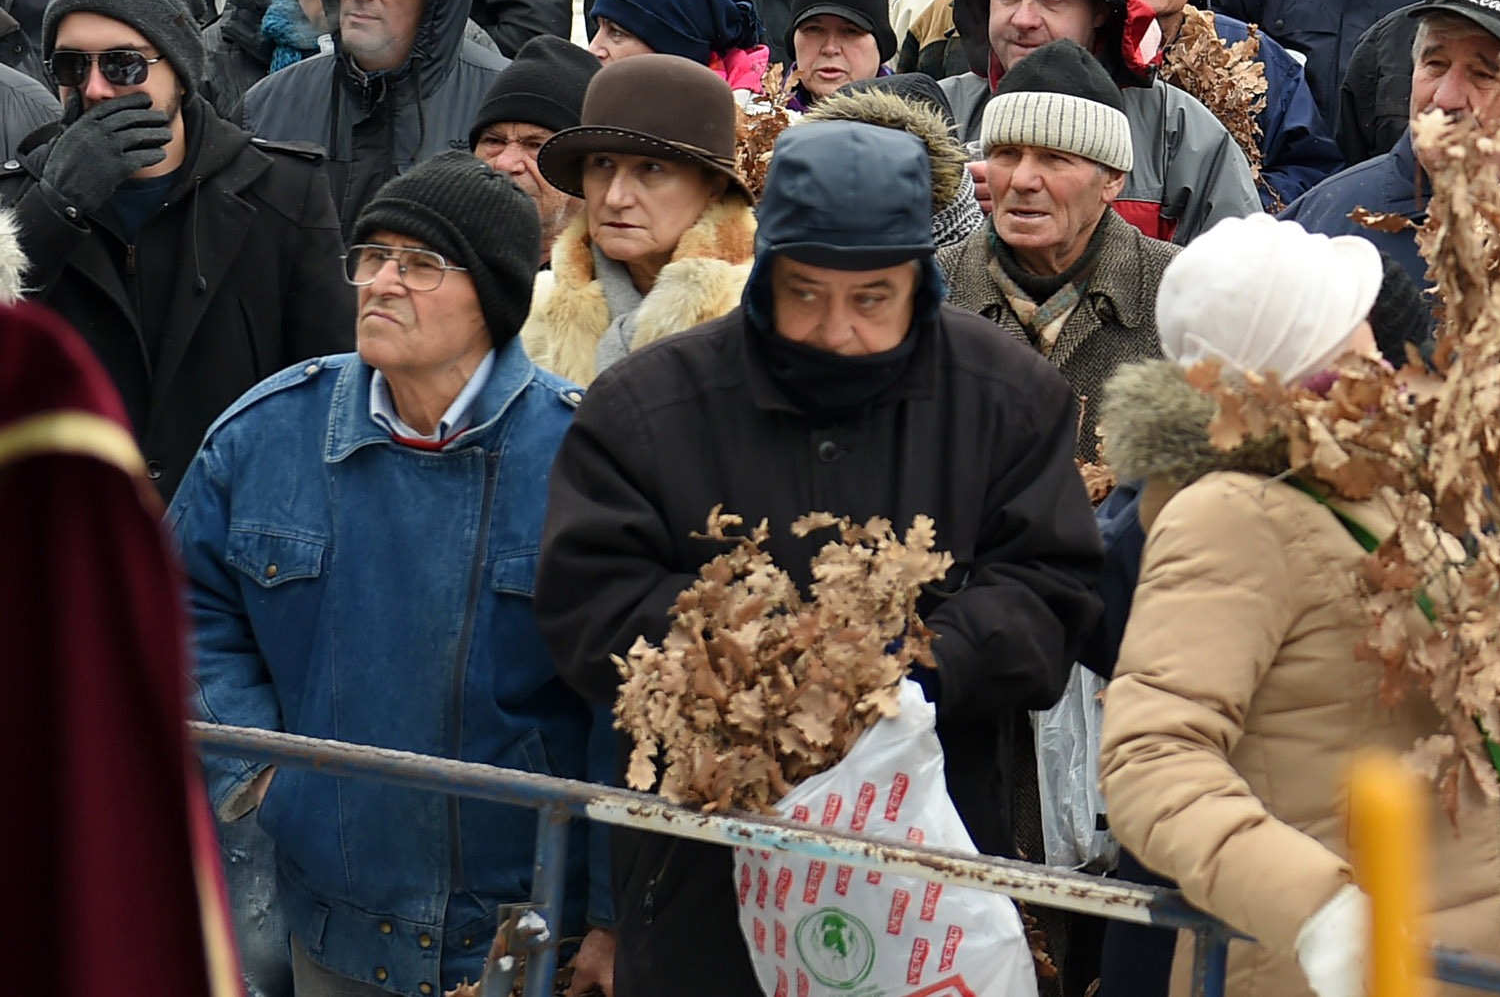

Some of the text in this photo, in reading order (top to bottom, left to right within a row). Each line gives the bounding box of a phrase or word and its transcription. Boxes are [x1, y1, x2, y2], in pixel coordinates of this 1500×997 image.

[852, 783, 873, 830] VERO
[886, 775, 906, 820] VERO
[888, 890, 907, 934] VERO
[908, 940, 927, 985] VERO
[940, 927, 961, 971] VERO
